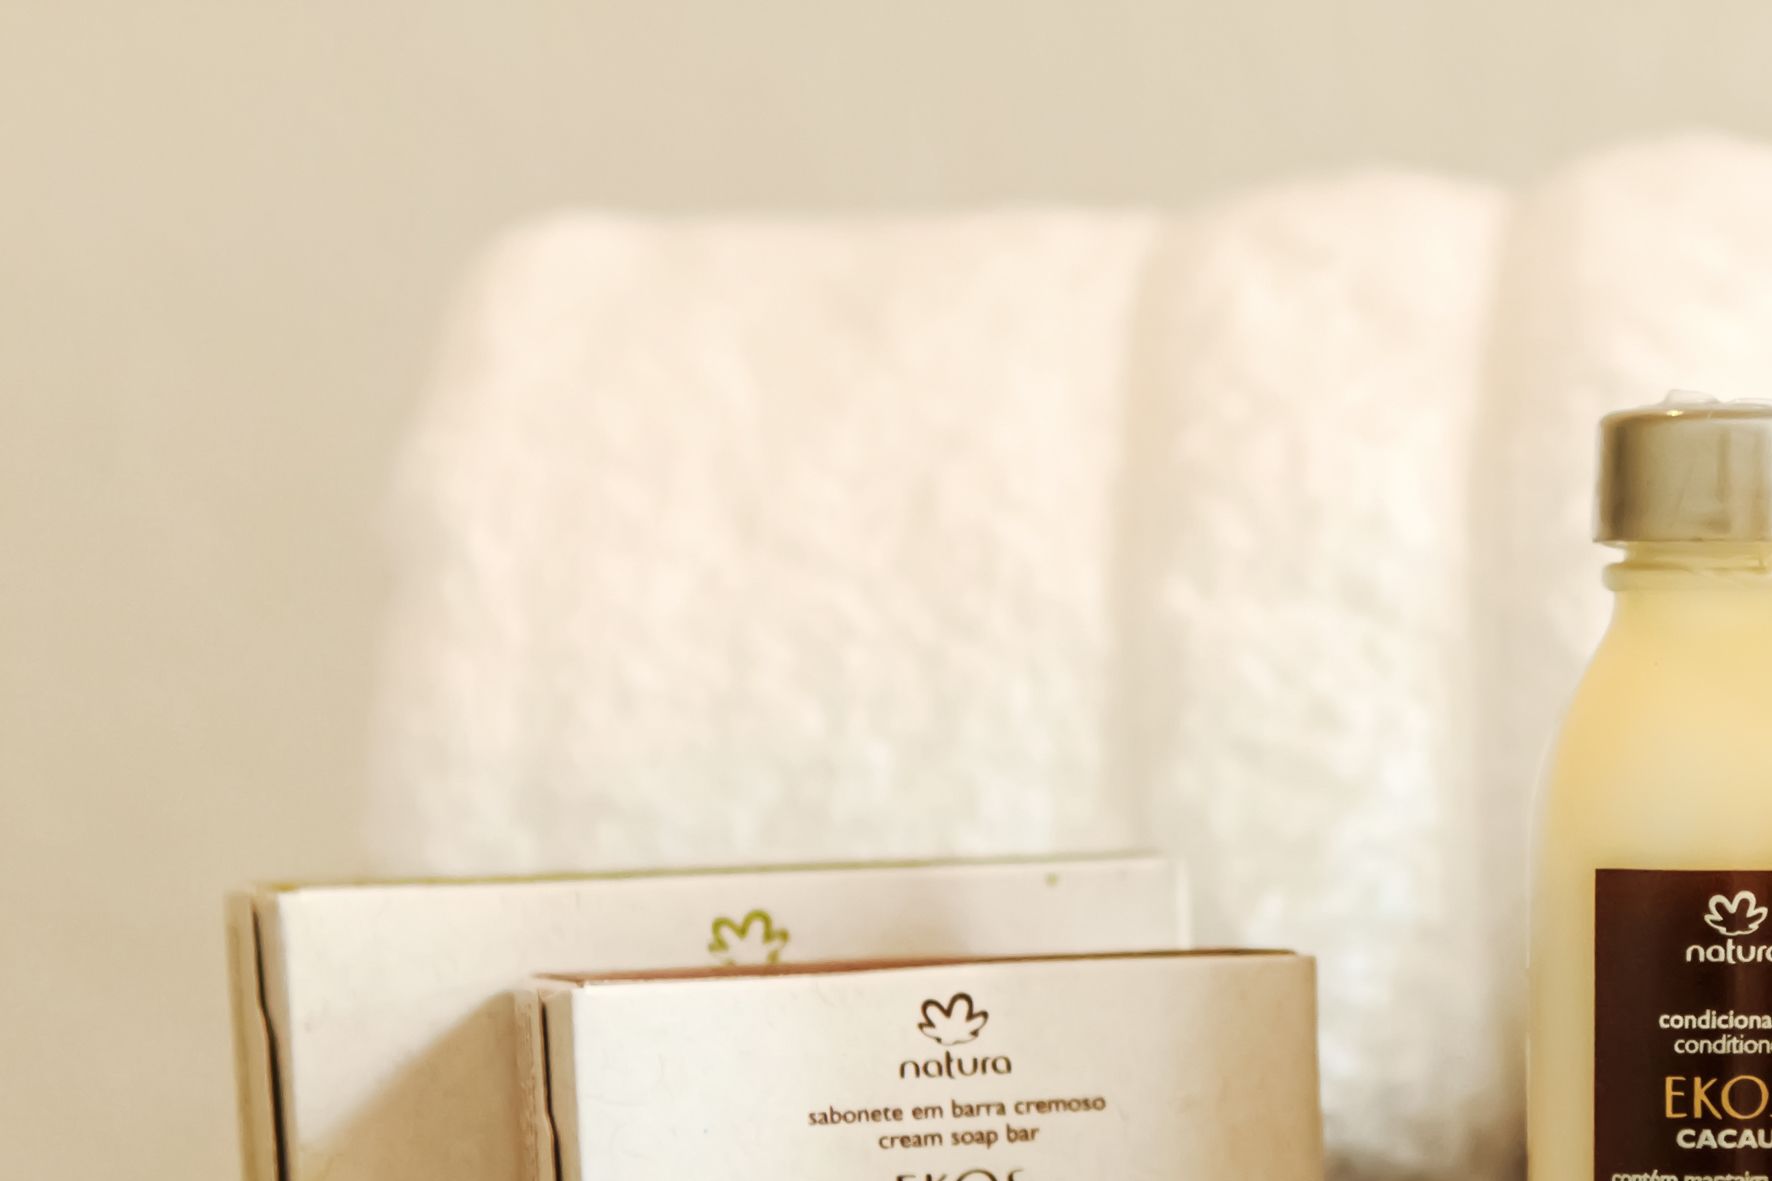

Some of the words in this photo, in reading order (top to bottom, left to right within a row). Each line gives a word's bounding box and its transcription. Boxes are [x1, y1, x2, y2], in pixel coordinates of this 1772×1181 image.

[899, 1051, 1012, 1079] natura
[808, 1106, 903, 1126] sabonete
[912, 1104, 943, 1120] em
[952, 1099, 1006, 1118] barra
[1014, 1096, 1106, 1115] cremoso
[878, 1132, 942, 1150] cream
[951, 1130, 998, 1150] soap
[1006, 1124, 1039, 1142] bar
